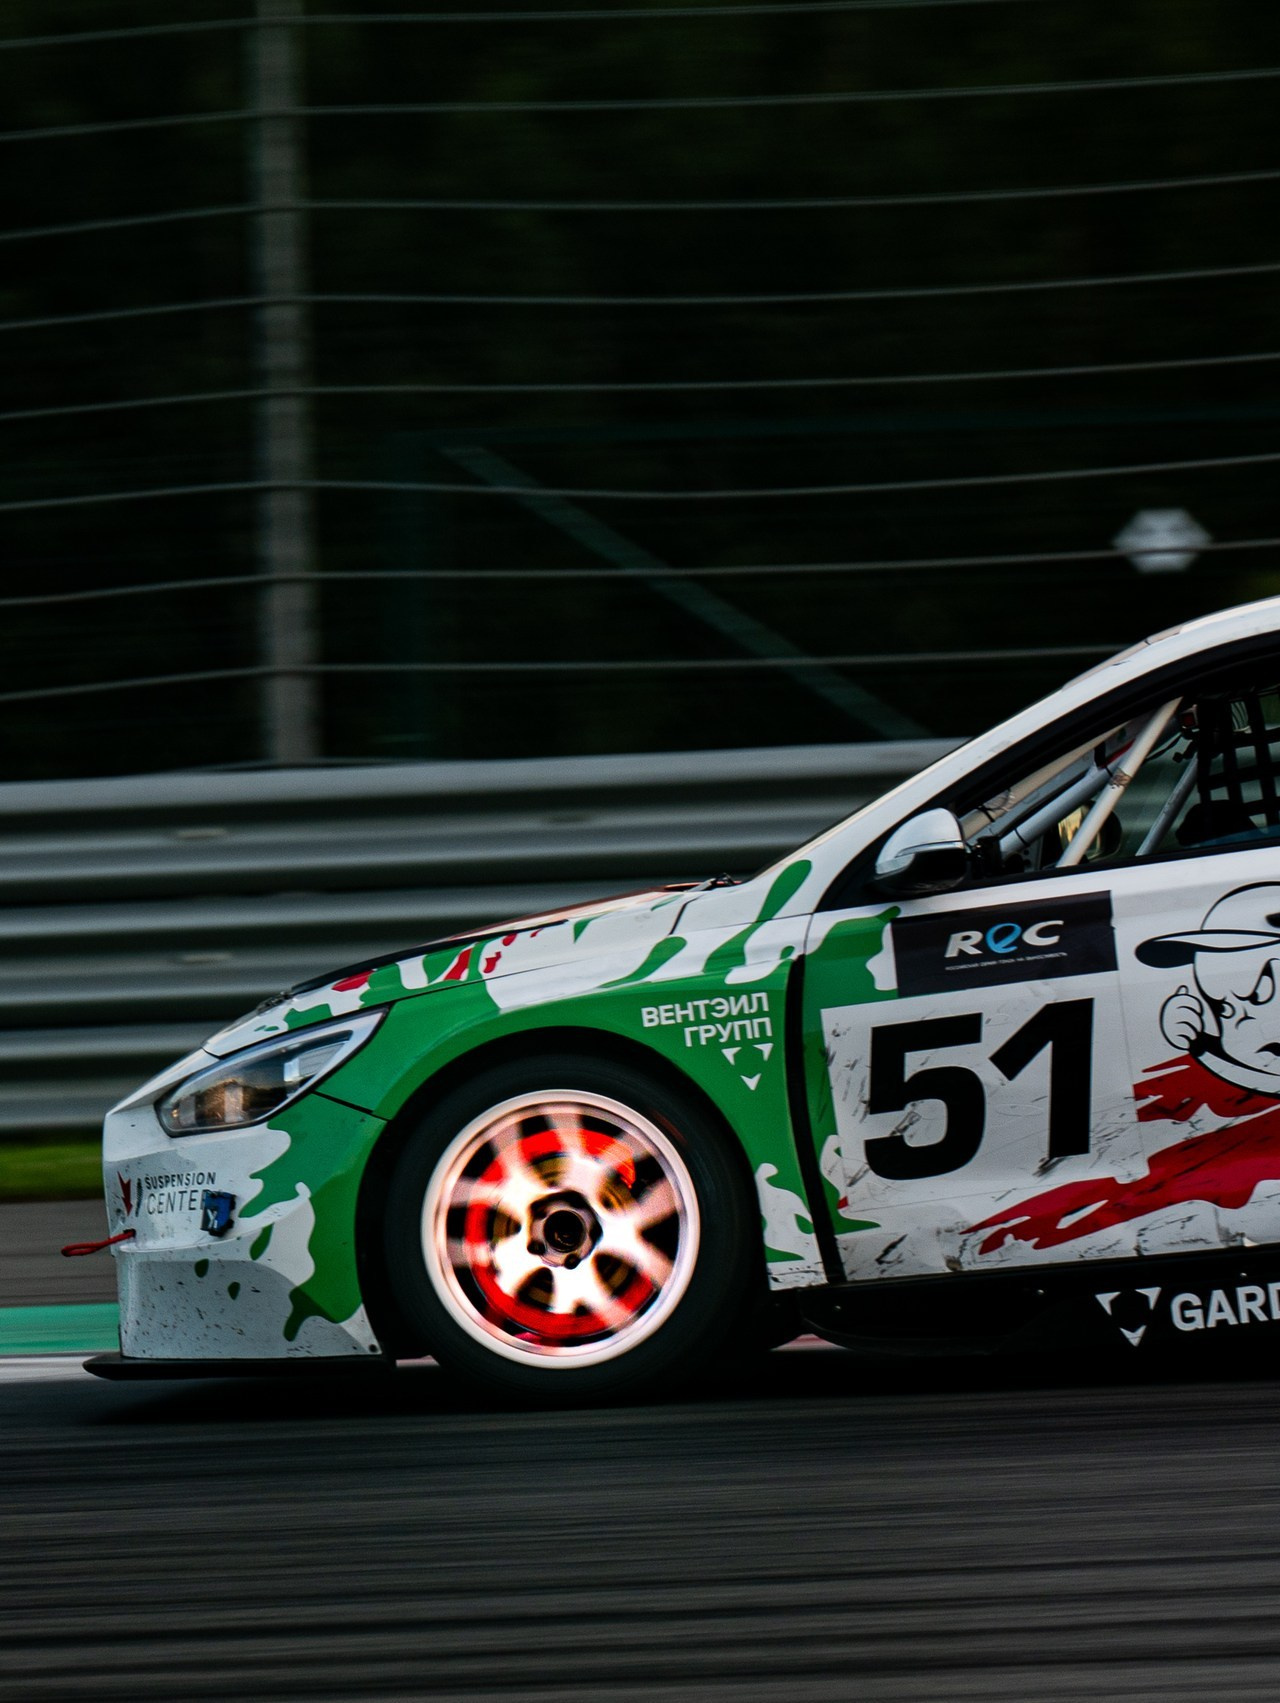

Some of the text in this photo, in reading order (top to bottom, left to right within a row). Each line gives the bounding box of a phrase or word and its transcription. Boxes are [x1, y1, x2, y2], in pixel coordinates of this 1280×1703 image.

[641, 992, 770, 1028] ВЕНТЭИЛ
[684, 1017, 773, 1048] ГРУПП
[863, 997, 1095, 1182] 51
[144, 1171, 217, 1191] SUSPENSION
[146, 1188, 206, 1216] CENTE
